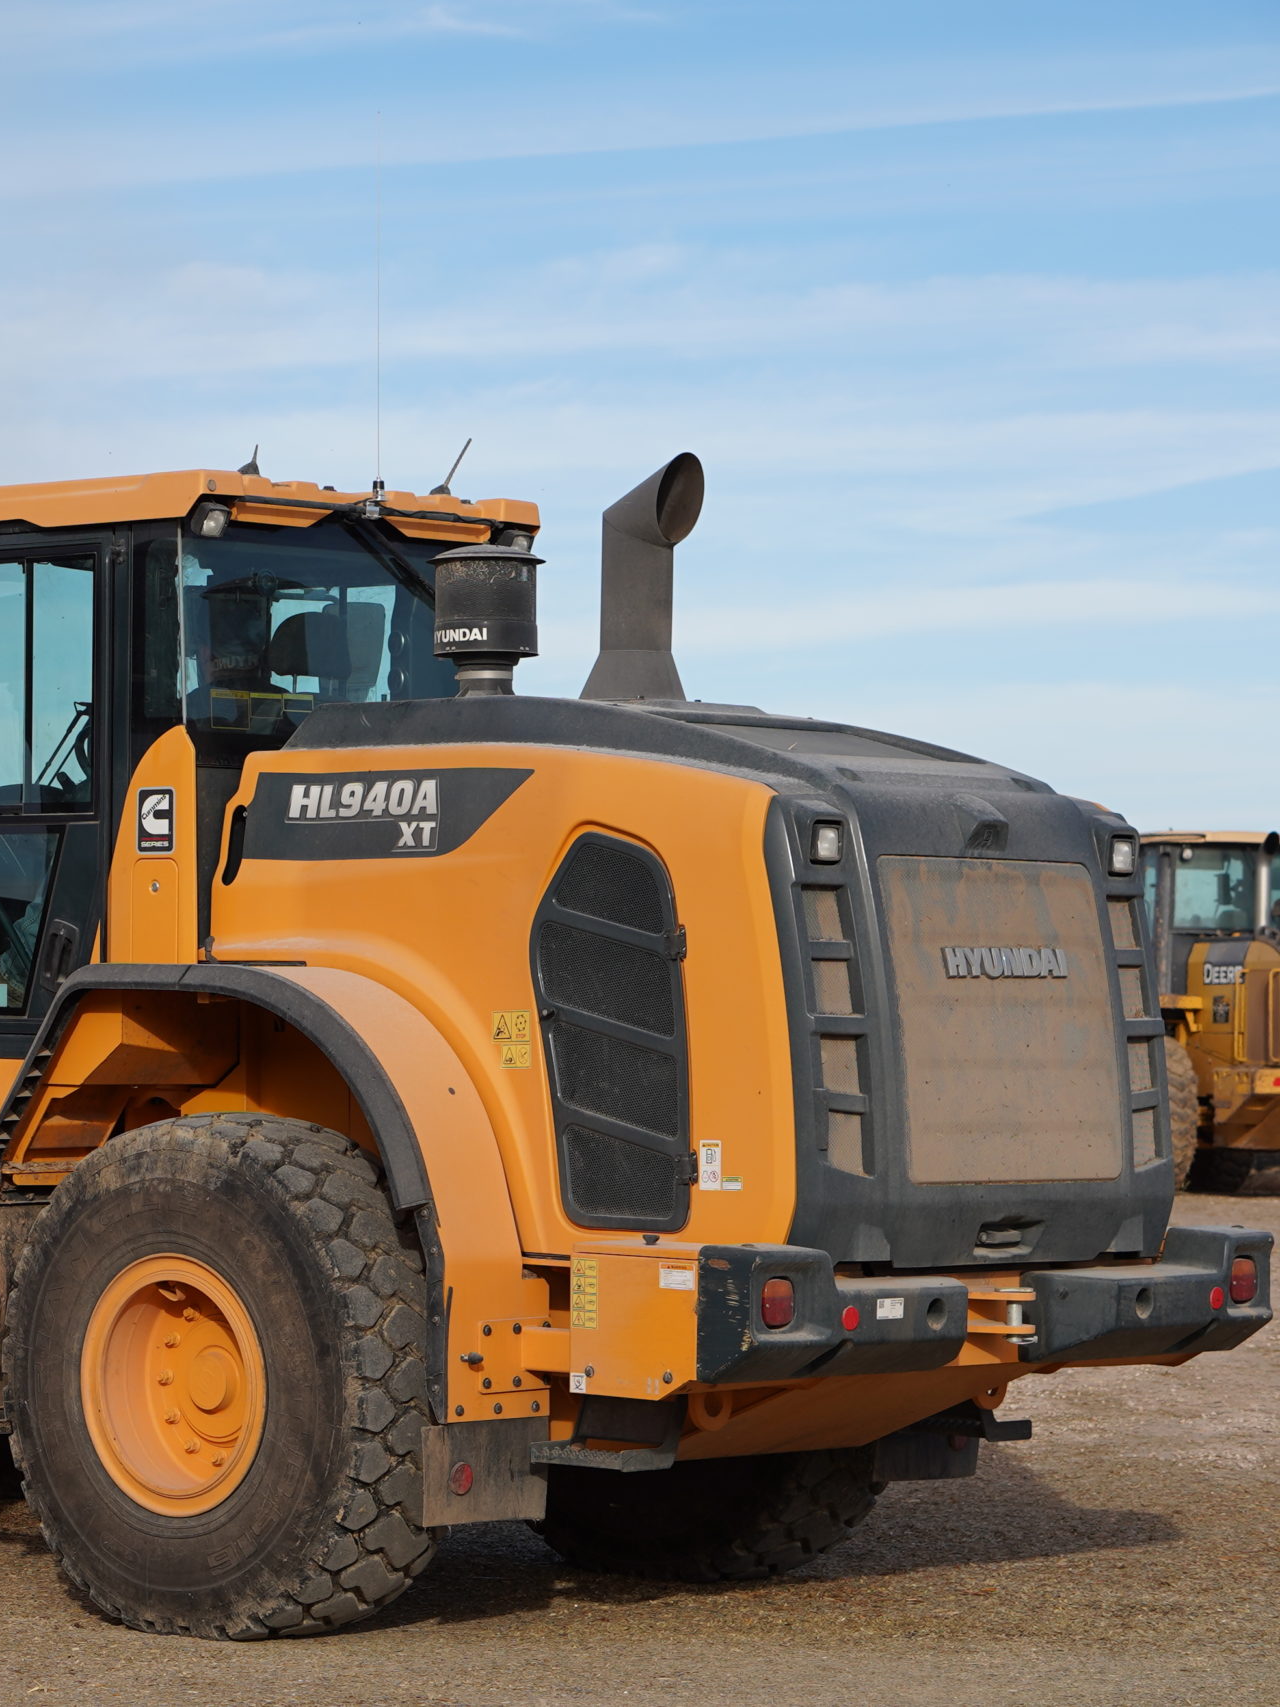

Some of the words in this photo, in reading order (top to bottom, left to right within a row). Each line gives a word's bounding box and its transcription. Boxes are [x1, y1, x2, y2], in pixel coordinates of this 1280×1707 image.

[141, 794, 167, 820] Cummins
[288, 780, 437, 818] HL940A
[397, 821, 436, 846] XT
[942, 947, 1067, 979] HYUNDAI
